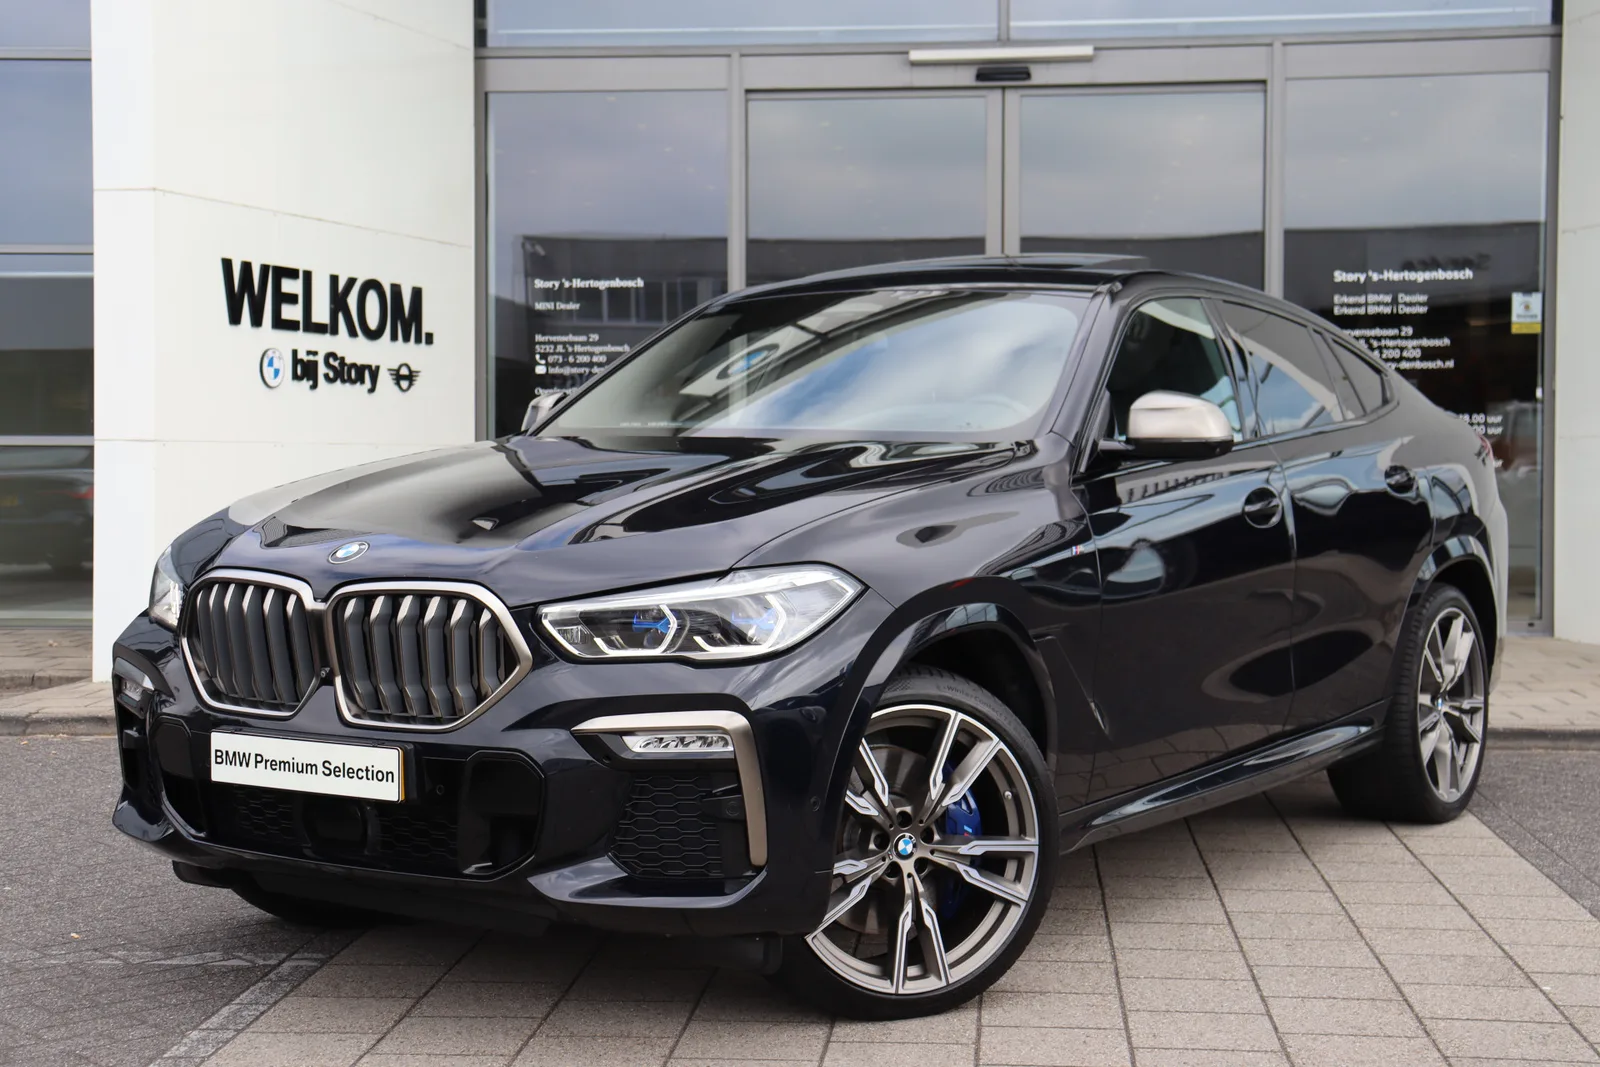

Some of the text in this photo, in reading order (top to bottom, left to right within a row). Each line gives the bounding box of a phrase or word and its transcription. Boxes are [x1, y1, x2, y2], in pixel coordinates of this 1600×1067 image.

[1333, 268, 1474, 284] Story 's-Hertogenbosch
[534, 277, 644, 291] Story 's-Hertogenbosch
[221, 257, 434, 345] WELKOM.
[1333, 292, 1429, 304] Erkend BMW Dealer
[534, 301, 580, 311] MINI Dealer
[1333, 305, 1366, 315] Erkend
[1367, 305, 1392, 314] BMW
[1398, 304, 1429, 314] Dealer
[1400, 325, 1413, 336] 29
[588, 333, 599, 342] 29
[535, 344, 554, 353] 5232
[1381, 348, 1401, 359] 200
[1402, 348, 1421, 359] 400
[547, 355, 563, 363] 073
[568, 355, 575, 363] 6
[575, 355, 591, 363] 200
[591, 355, 607, 363] 400
[291, 348, 381, 393] bij Story
[1487, 415, 1503, 424] uur
[1487, 426, 1504, 435] uur
[214, 749, 395, 783] BMW Premium Selection
